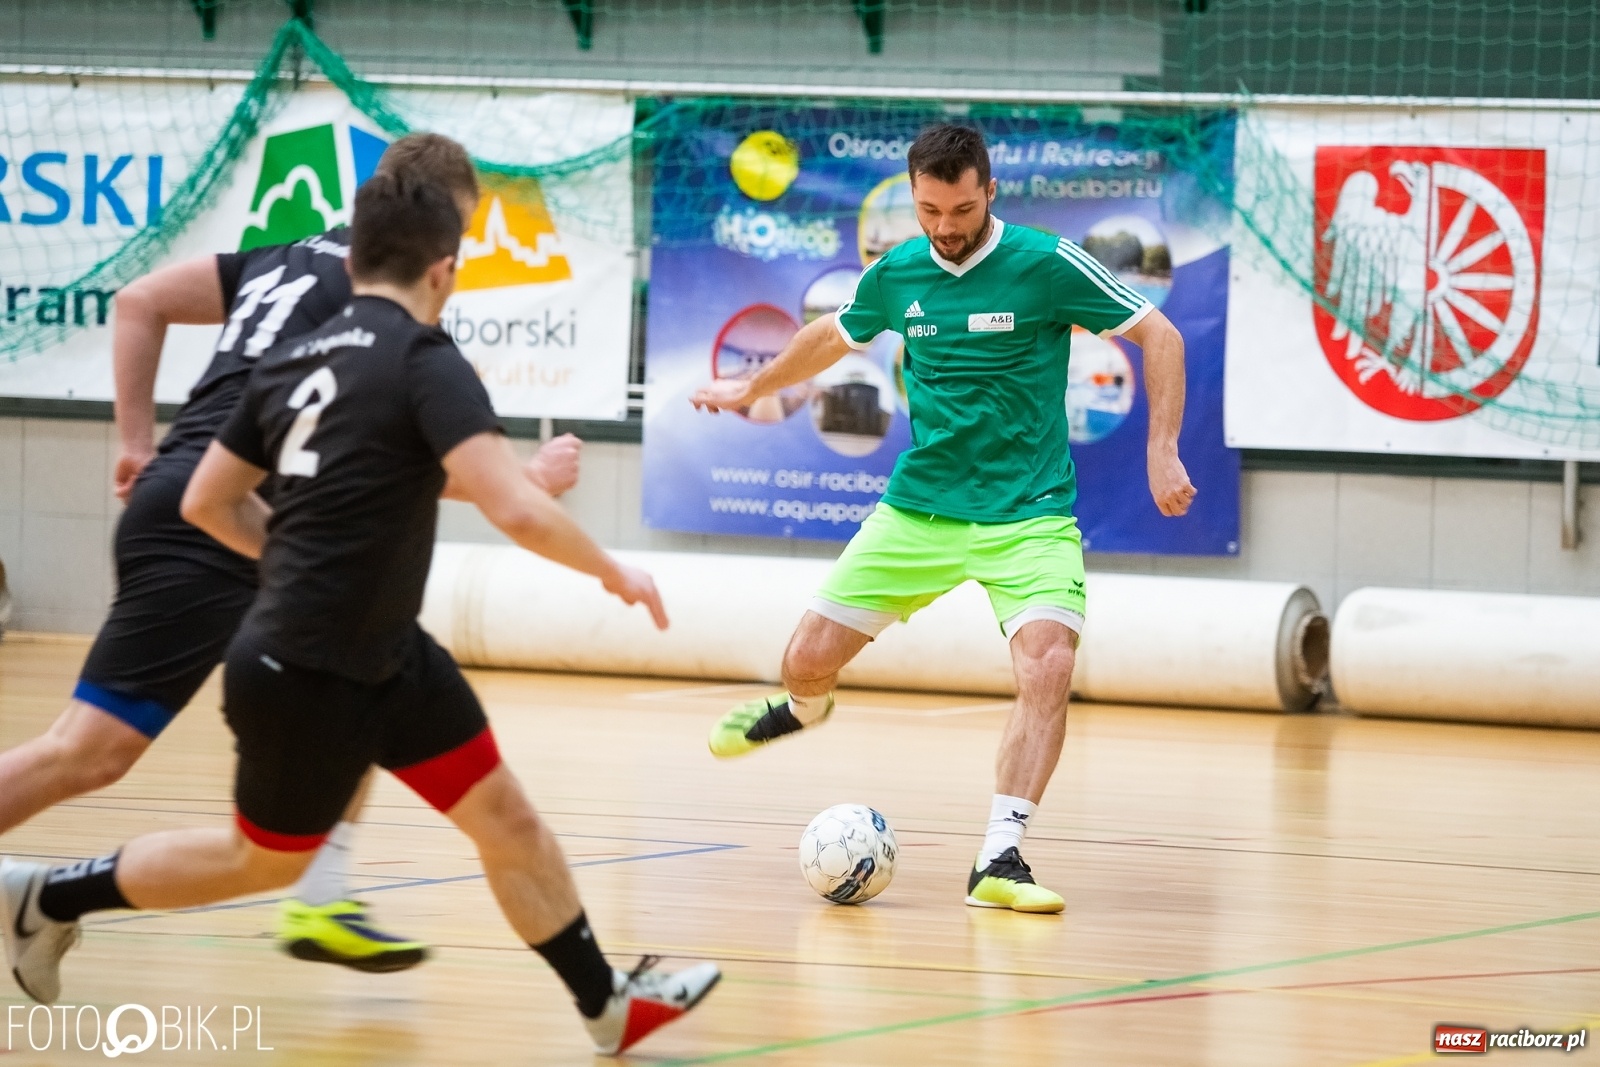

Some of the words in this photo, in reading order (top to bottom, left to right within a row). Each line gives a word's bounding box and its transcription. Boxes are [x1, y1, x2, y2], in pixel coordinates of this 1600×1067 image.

[5, 286, 117, 326] ram
[219, 265, 317, 357] 11
[990, 315, 1013, 323] A&B
[446, 307, 577, 347] iborski
[278, 366, 337, 478] 2
